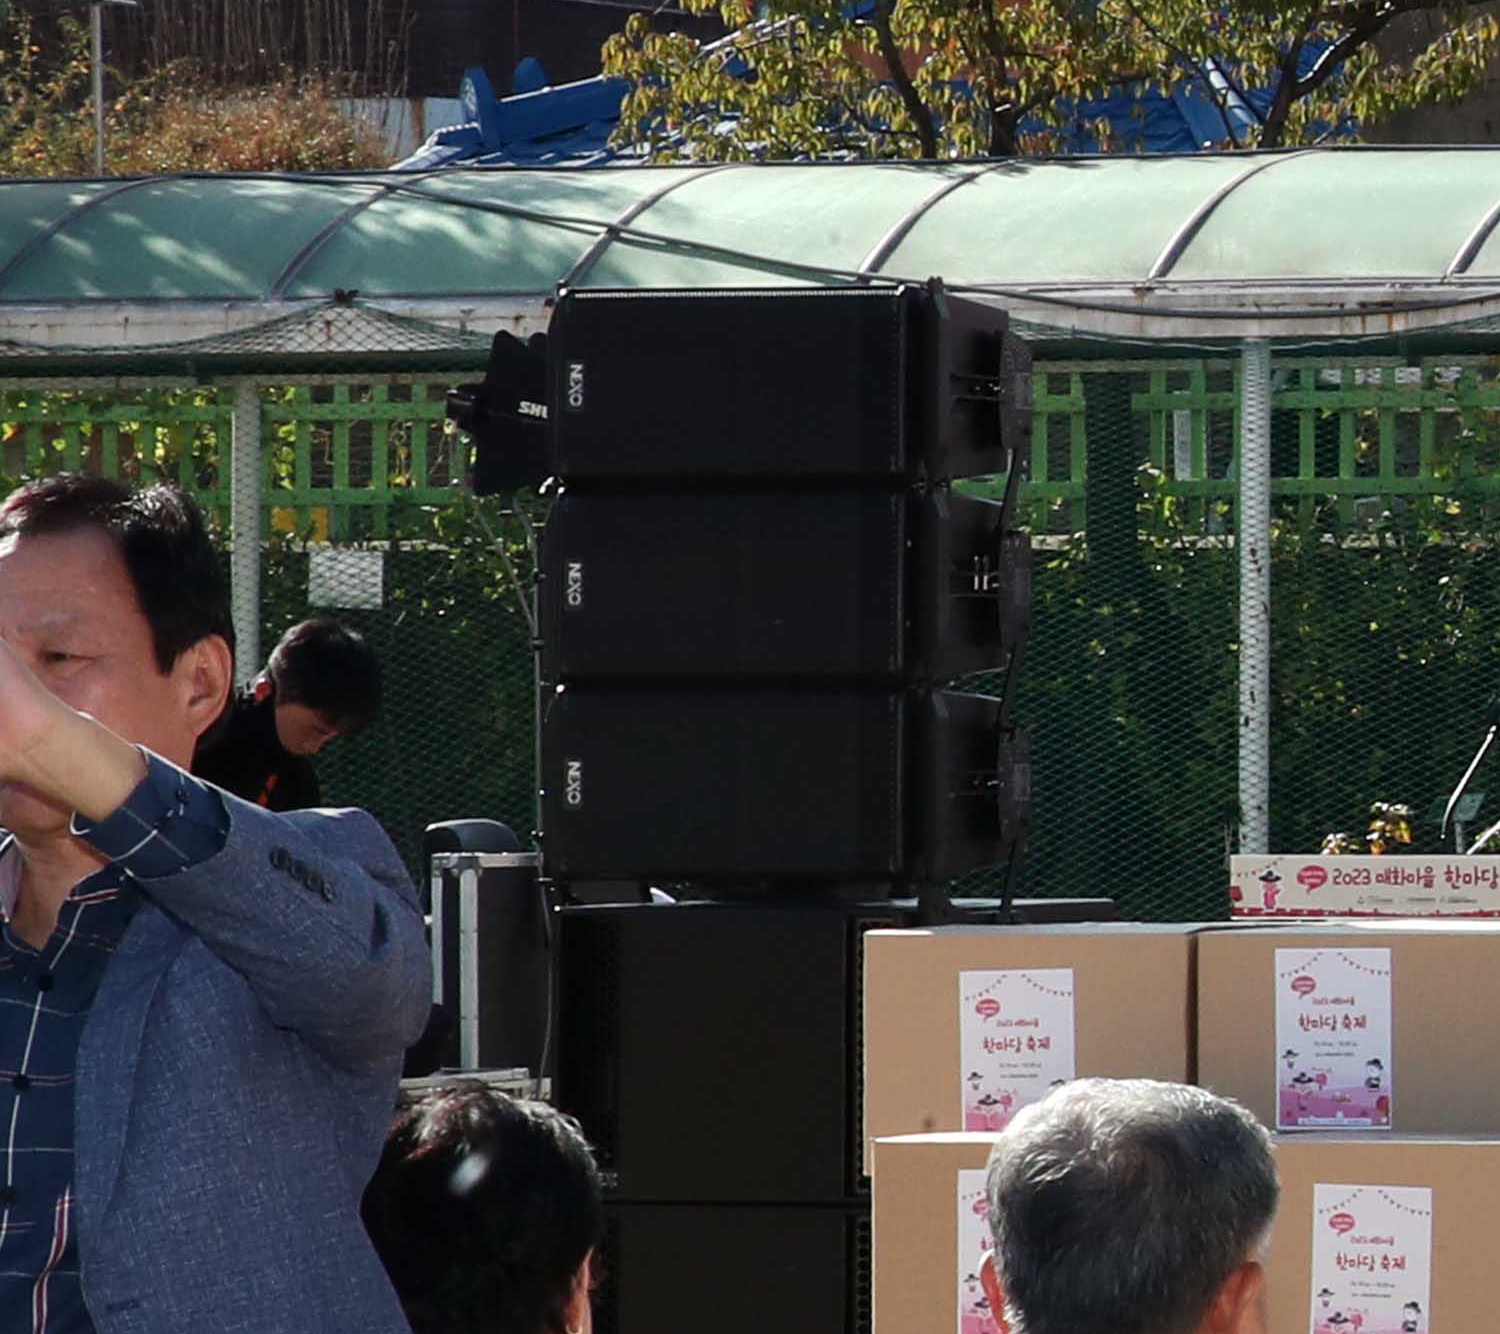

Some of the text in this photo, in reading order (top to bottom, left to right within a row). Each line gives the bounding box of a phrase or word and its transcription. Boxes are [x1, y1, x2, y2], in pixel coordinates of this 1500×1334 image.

[569, 364, 583, 407] NEXO
[568, 563, 582, 605] NEXO
[567, 761, 581, 803] NEXO
[1332, 869, 1371, 886] 2023
[1375, 866, 1435, 889] 매화마을
[1444, 865, 1499, 890] 한마당
[1298, 1013, 1337, 1032] 한마당
[982, 1036, 1022, 1054] 한마당
[1336, 1251, 1375, 1272] 한마당
